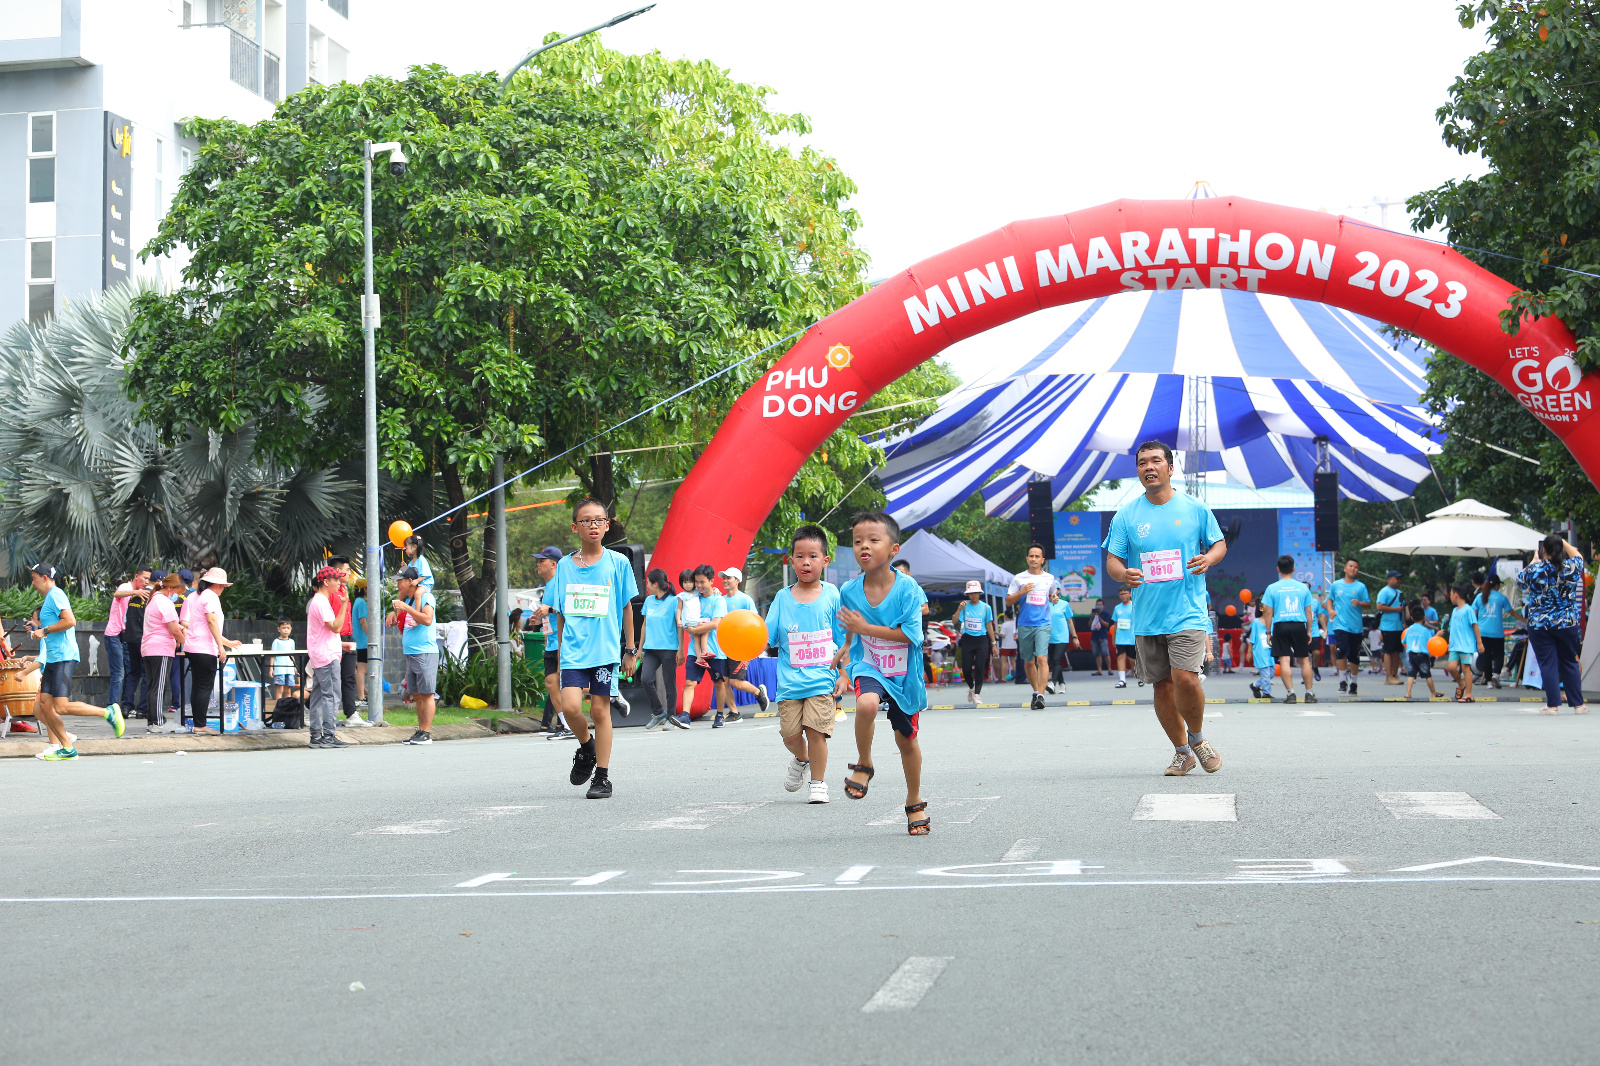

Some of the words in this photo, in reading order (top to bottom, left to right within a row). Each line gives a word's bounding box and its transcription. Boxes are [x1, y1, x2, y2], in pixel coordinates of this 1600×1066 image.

[903, 255, 1024, 335] MINI
[1035, 228, 1336, 288] MARATHON
[1348, 251, 1468, 319] 2023
[1120, 266, 1266, 294] START
[1508, 346, 1540, 358] LET'S
[765, 365, 828, 391] PHU
[1511, 355, 1582, 394] GO
[762, 391, 858, 417] DONG
[1516, 391, 1592, 412] GREEN
[1534, 411, 1570, 422] SEASON
[1572, 414, 1578, 422] 3
[573, 598, 596, 610] 0371
[797, 646, 826, 660] 0589
